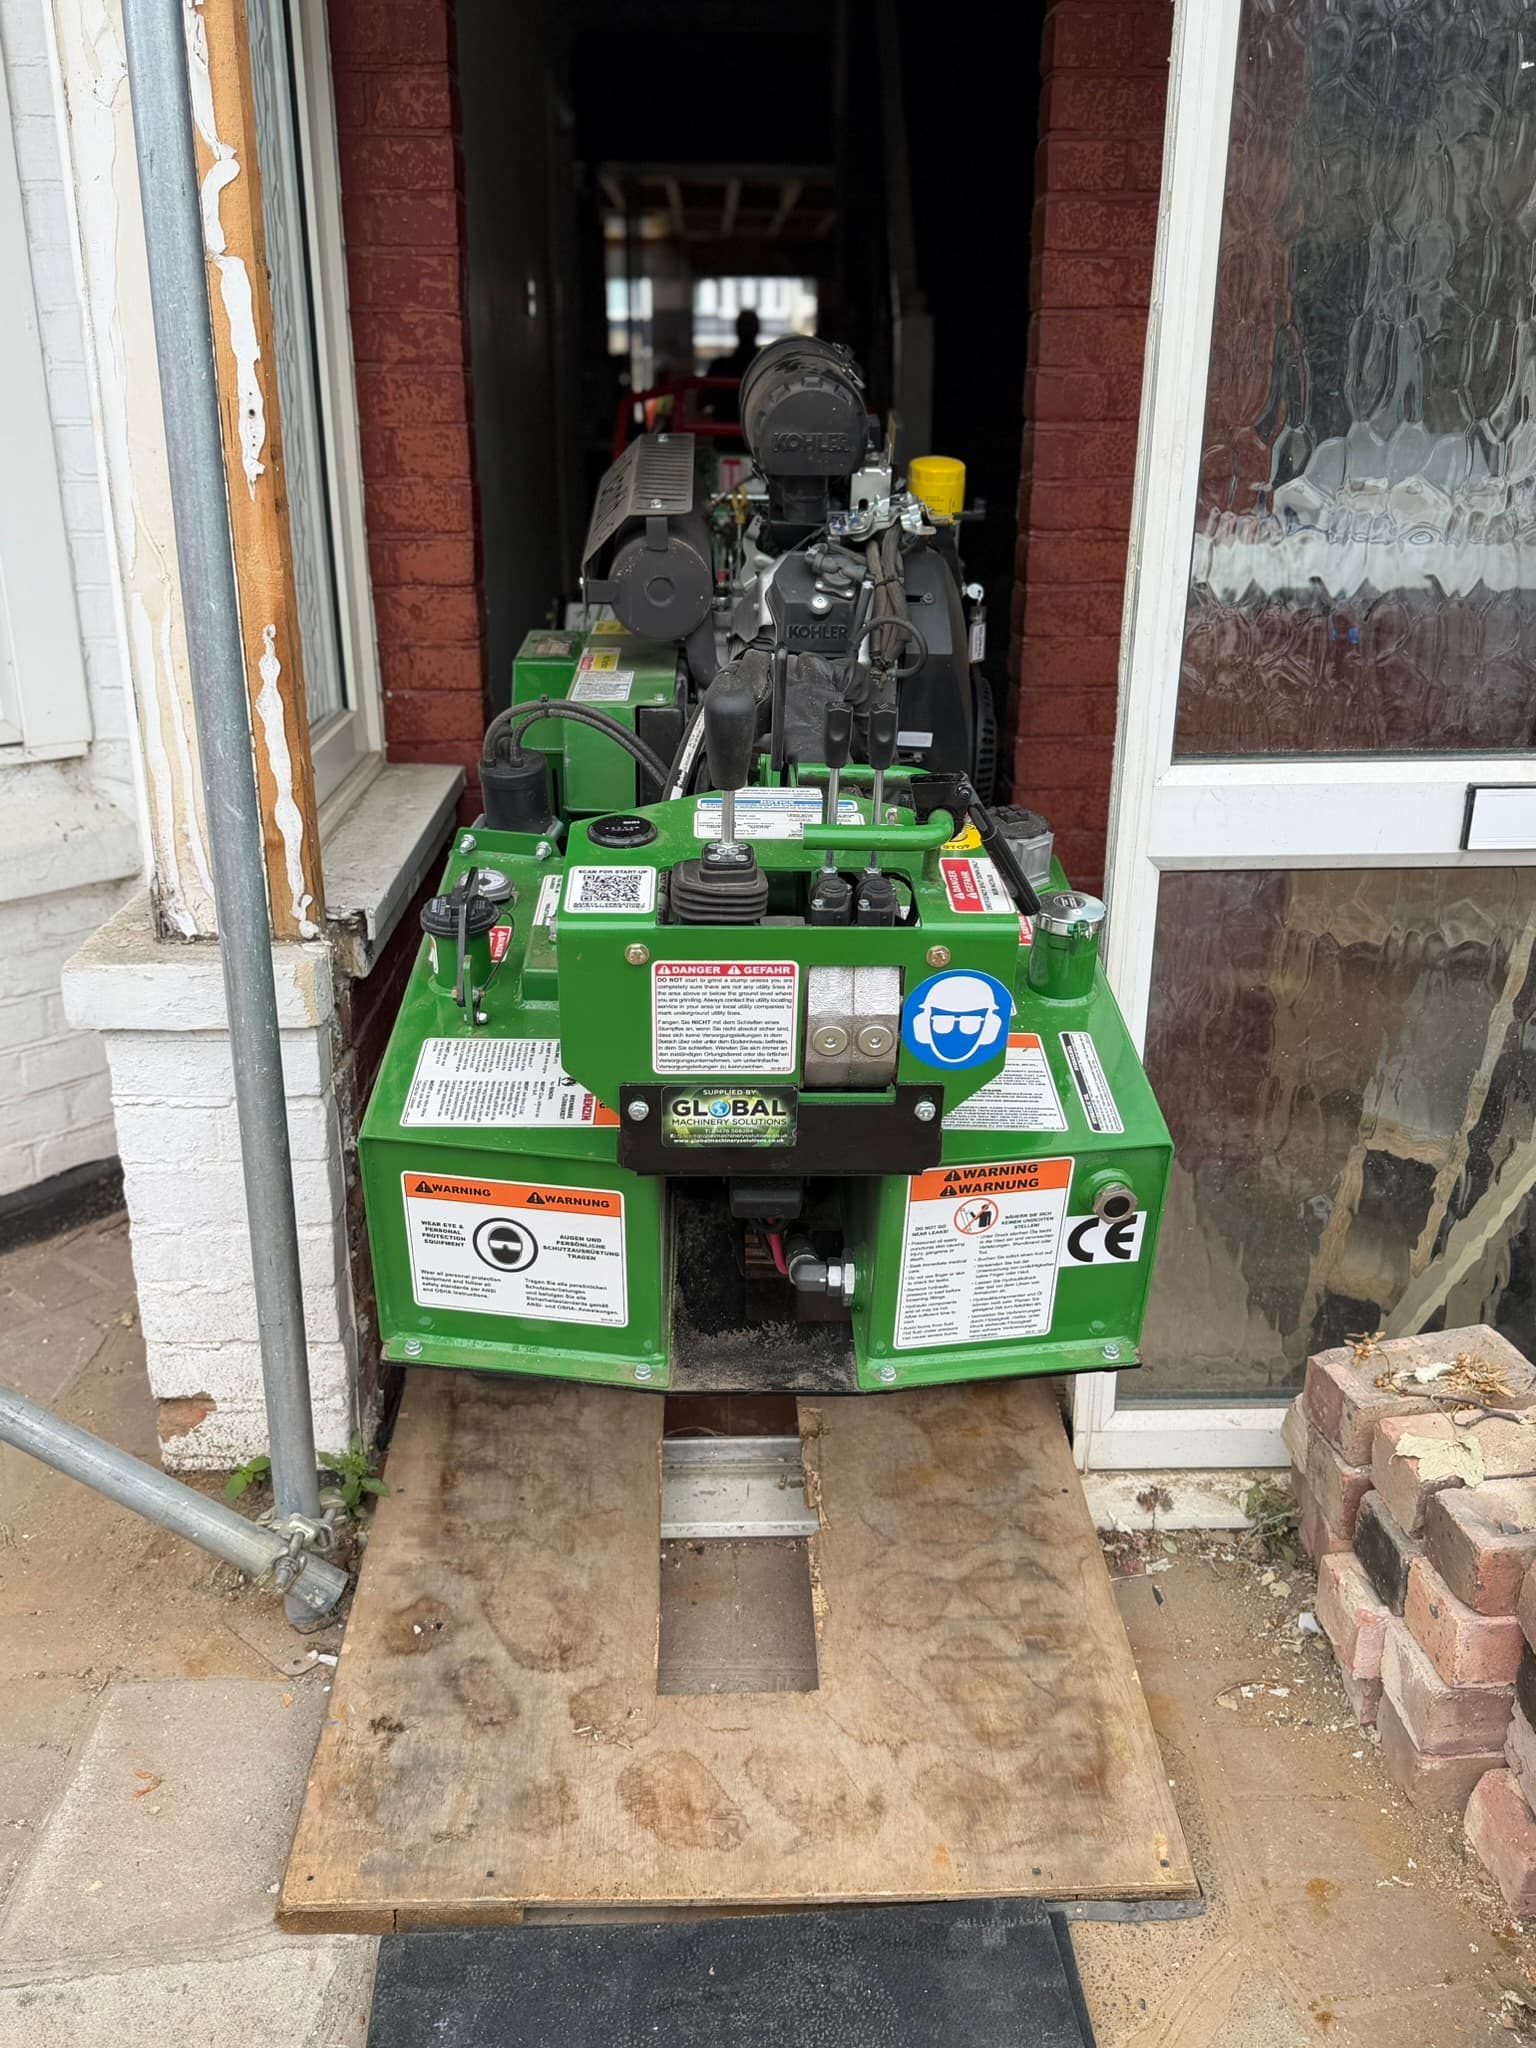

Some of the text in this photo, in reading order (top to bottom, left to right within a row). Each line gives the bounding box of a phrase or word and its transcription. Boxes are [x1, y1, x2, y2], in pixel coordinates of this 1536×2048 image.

[772, 432, 848, 452] KOHLER
[784, 624, 848, 640] KOHLER
[948, 870, 962, 894] DANGER
[960, 871, 974, 894] GEFAHR
[672, 966, 790, 974] DANGER GEFAHR
[581, 1094, 593, 1120] BENZIN
[963, 1164, 1039, 1180] WARNING
[432, 1184, 491, 1197] WARNING
[959, 1178, 1040, 1193] WARNUNG
[545, 1195, 610, 1208] WARNUNG
[422, 1233, 466, 1242] PROTECTION
[424, 1227, 462, 1235] PERSONAL
[1067, 1214, 1138, 1263] CE
[424, 1239, 465, 1248] EQUIPMENT
[556, 1240, 606, 1250] PERSÖNLICHE
